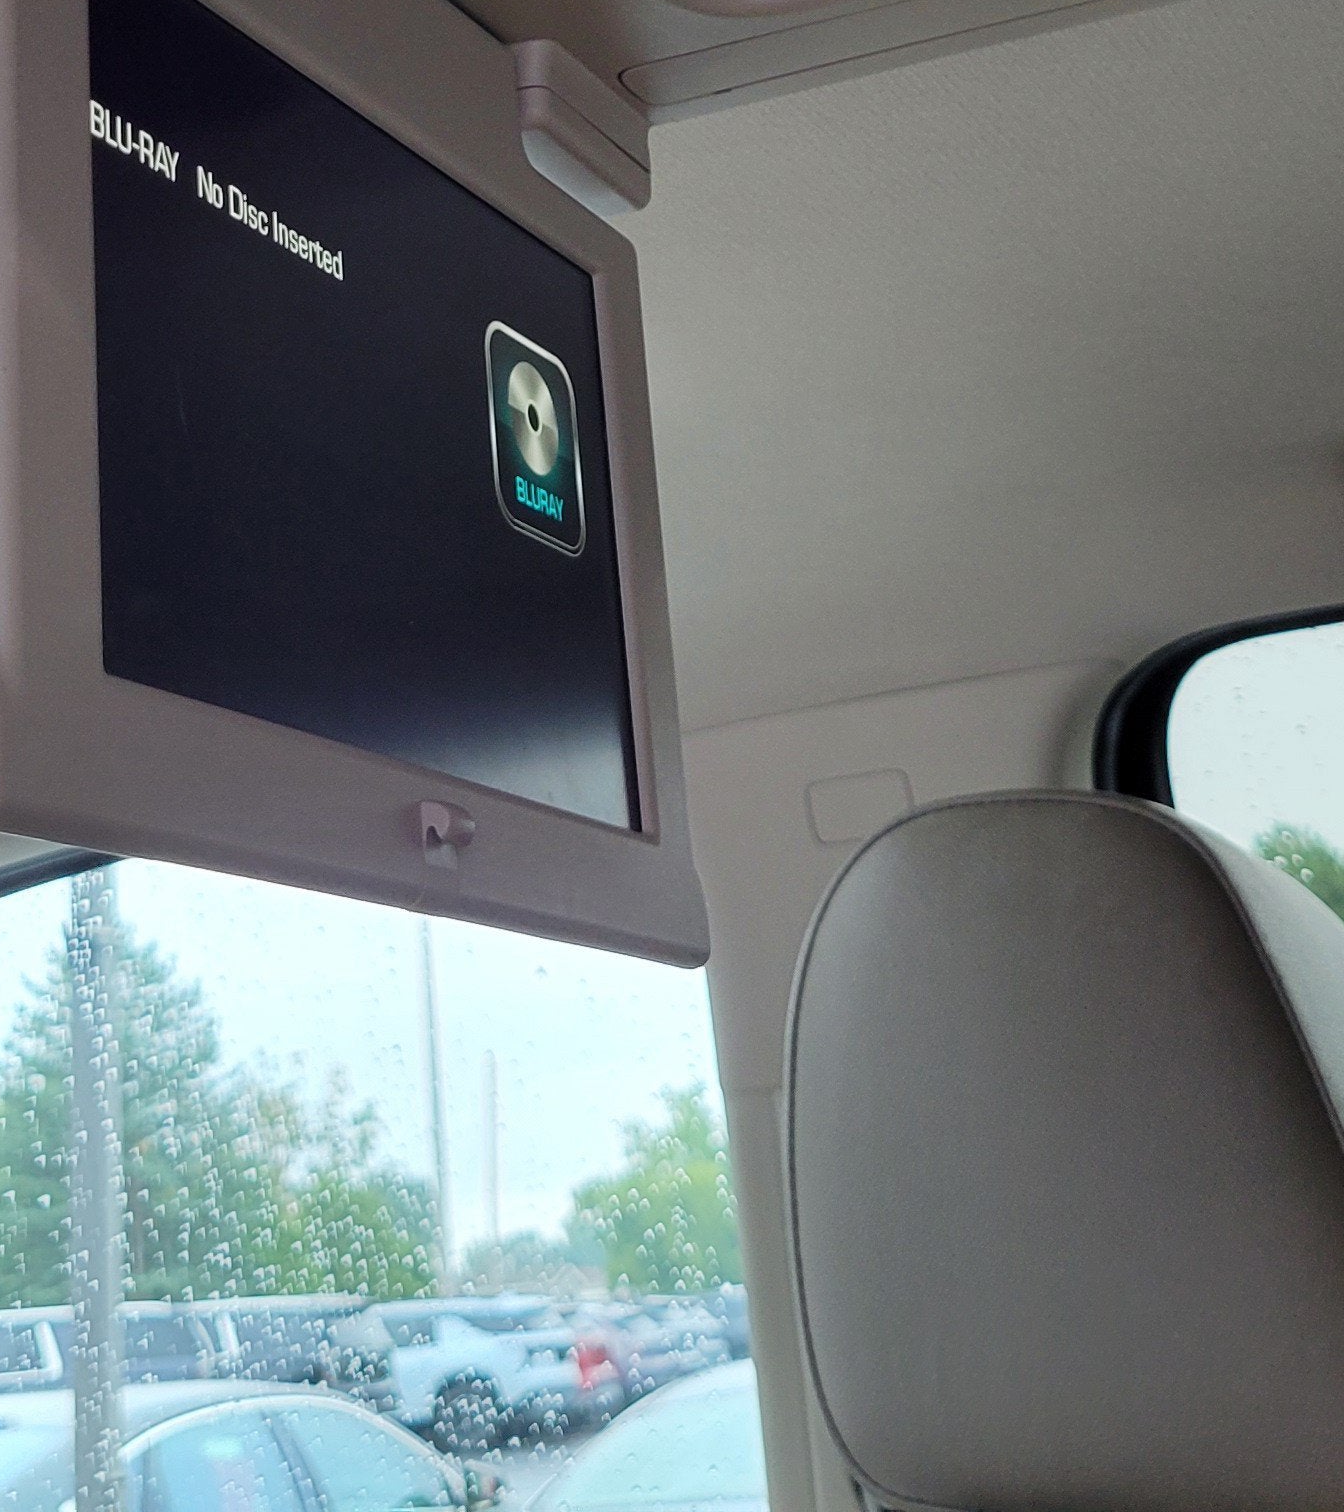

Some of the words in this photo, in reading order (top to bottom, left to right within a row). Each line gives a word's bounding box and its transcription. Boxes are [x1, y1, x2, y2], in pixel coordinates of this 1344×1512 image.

[89, 100, 179, 182] BLU-RAY
[196, 165, 224, 209] No
[229, 185, 269, 235] Disc
[273, 211, 344, 280] Inserted
[516, 476, 564, 522] BLURAY
